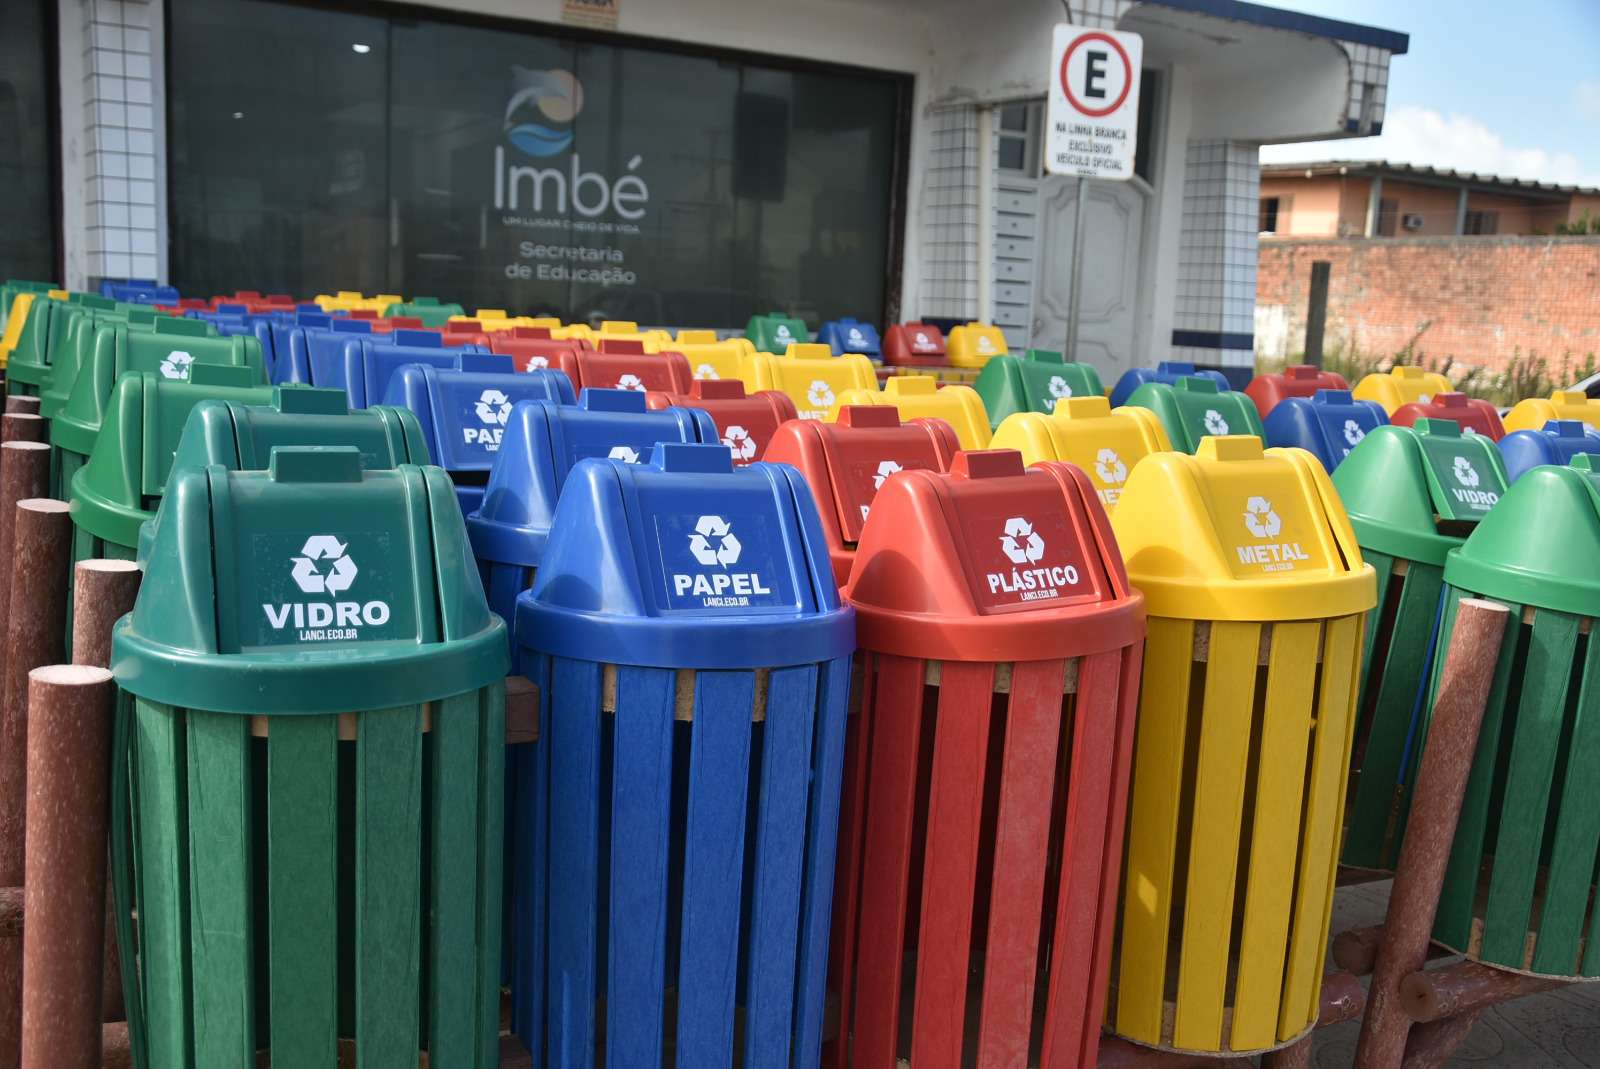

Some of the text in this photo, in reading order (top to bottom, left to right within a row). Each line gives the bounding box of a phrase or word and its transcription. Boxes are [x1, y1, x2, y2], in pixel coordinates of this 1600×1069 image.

[1085, 49, 1107, 99] E
[494, 145, 649, 219] Imbé
[519, 240, 624, 262] Secretaria
[504, 261, 637, 287] de Educação
[463, 428, 504, 444] PAP
[1451, 488, 1499, 505] VIDRO
[1236, 543, 1310, 564] METAL
[673, 573, 771, 596] PAPEL
[986, 565, 1079, 593] PLÁSTICO
[262, 600, 391, 629] VIDRO
[300, 629, 358, 641] LANCI.ECO.BR
